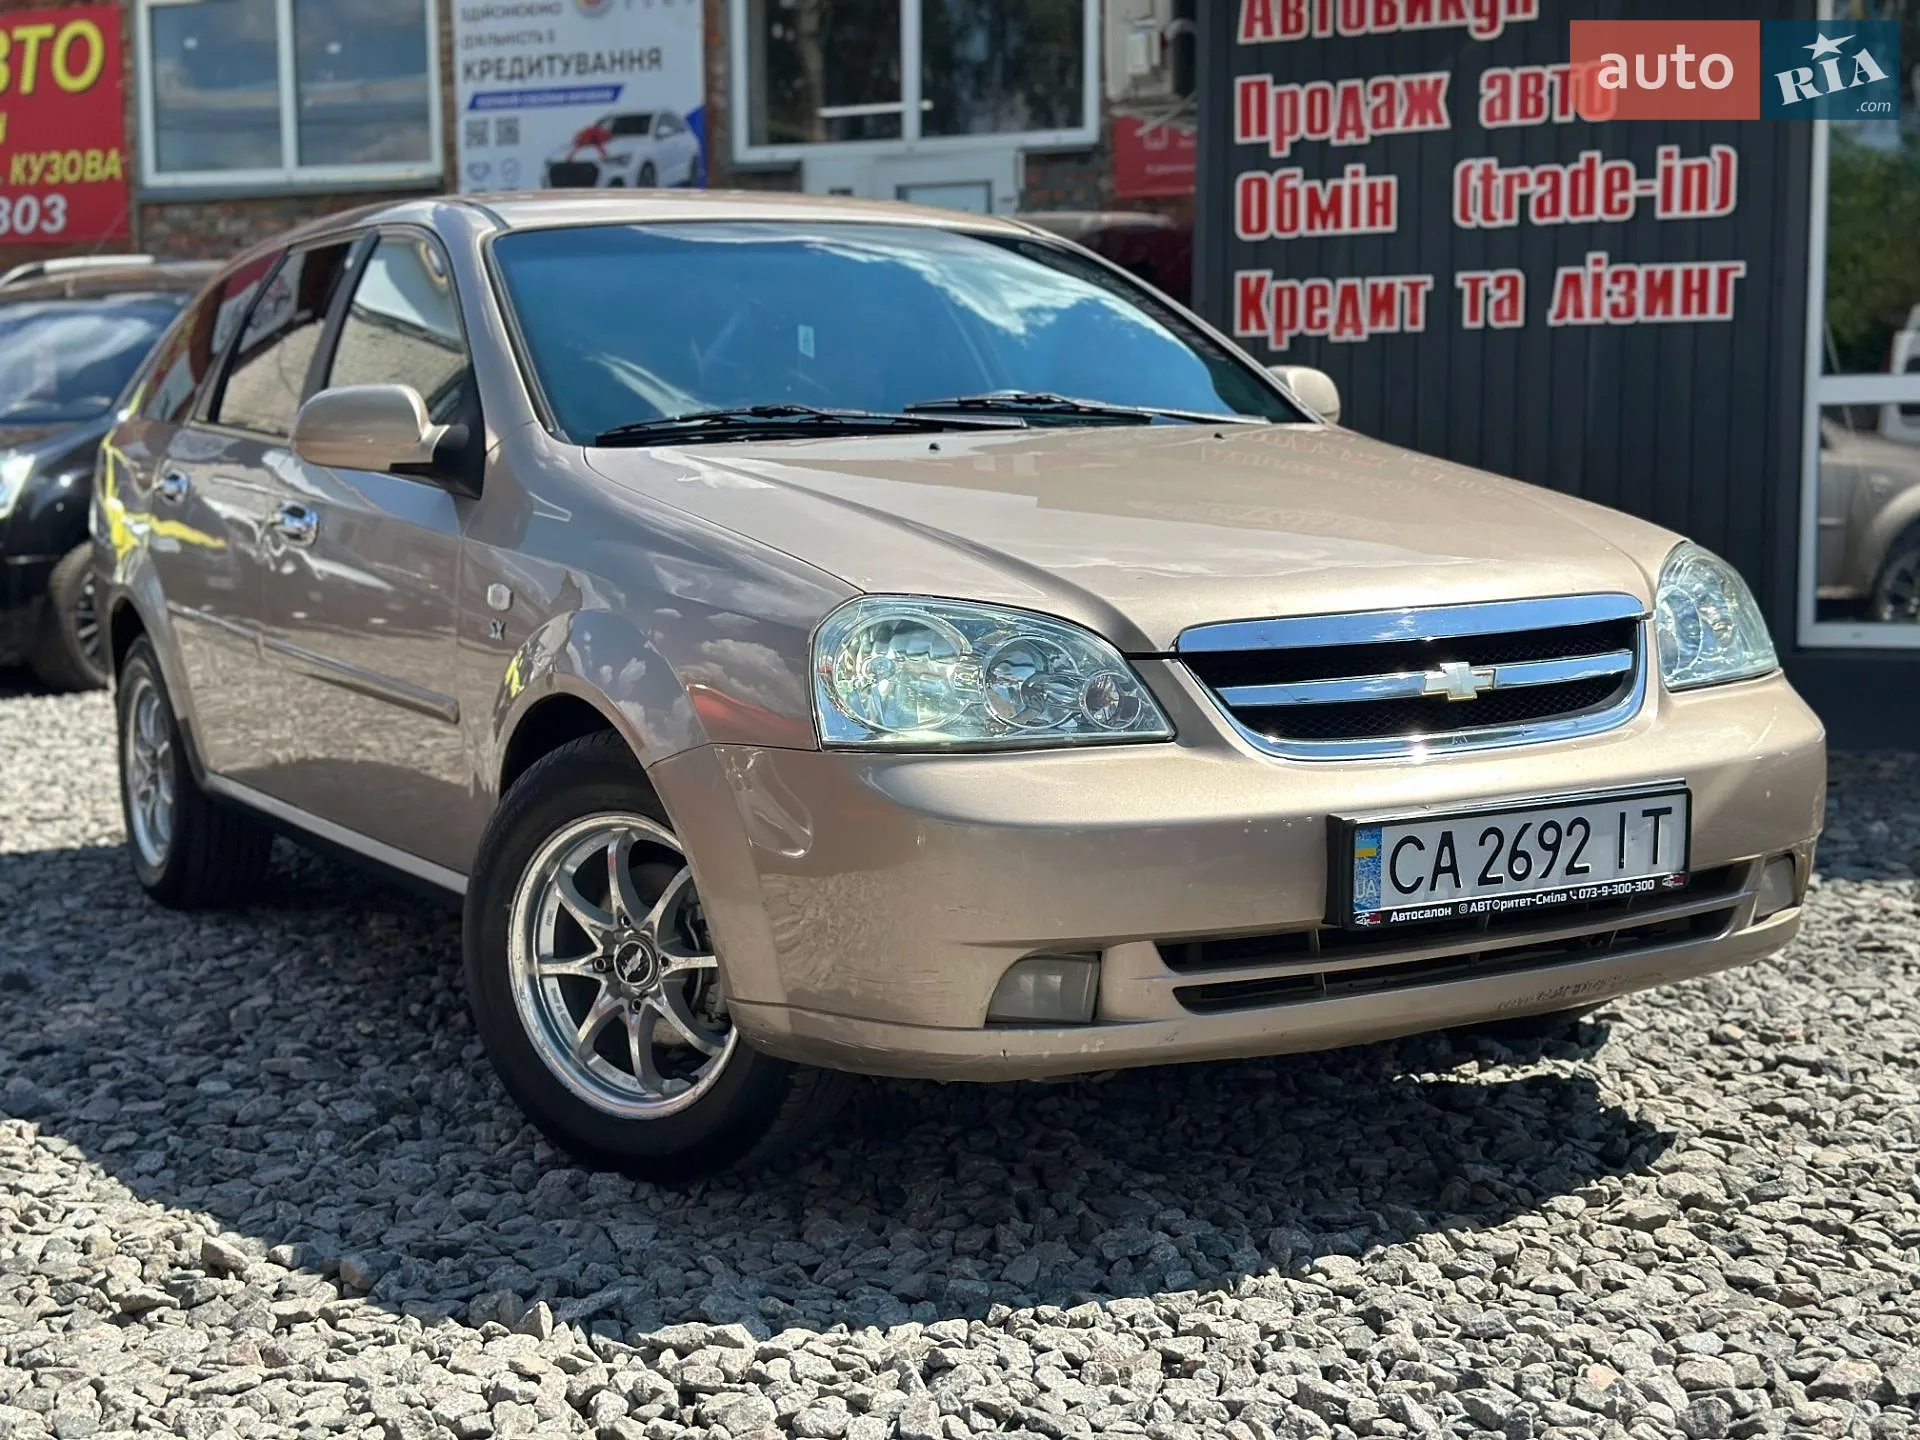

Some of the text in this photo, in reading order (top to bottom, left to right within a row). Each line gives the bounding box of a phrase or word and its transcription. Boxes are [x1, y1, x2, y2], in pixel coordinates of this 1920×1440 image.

[0, 20, 104, 95] ТО
[462, 46, 662, 83] КРЕДИТУВАННЯ
[1235, 60, 1618, 158] Продаж авто
[10, 147, 122, 186] КУЗОВА
[1235, 144, 1738, 241] Обмін (trade-in)
[1234, 251, 1747, 352] Кредит та лізинг
[1390, 806, 1672, 895] CA 2692 IT
[1355, 879, 1377, 898] UA
[1390, 879, 1655, 923] Автосалон АВТОритет-Сміла 073-9-300-300
